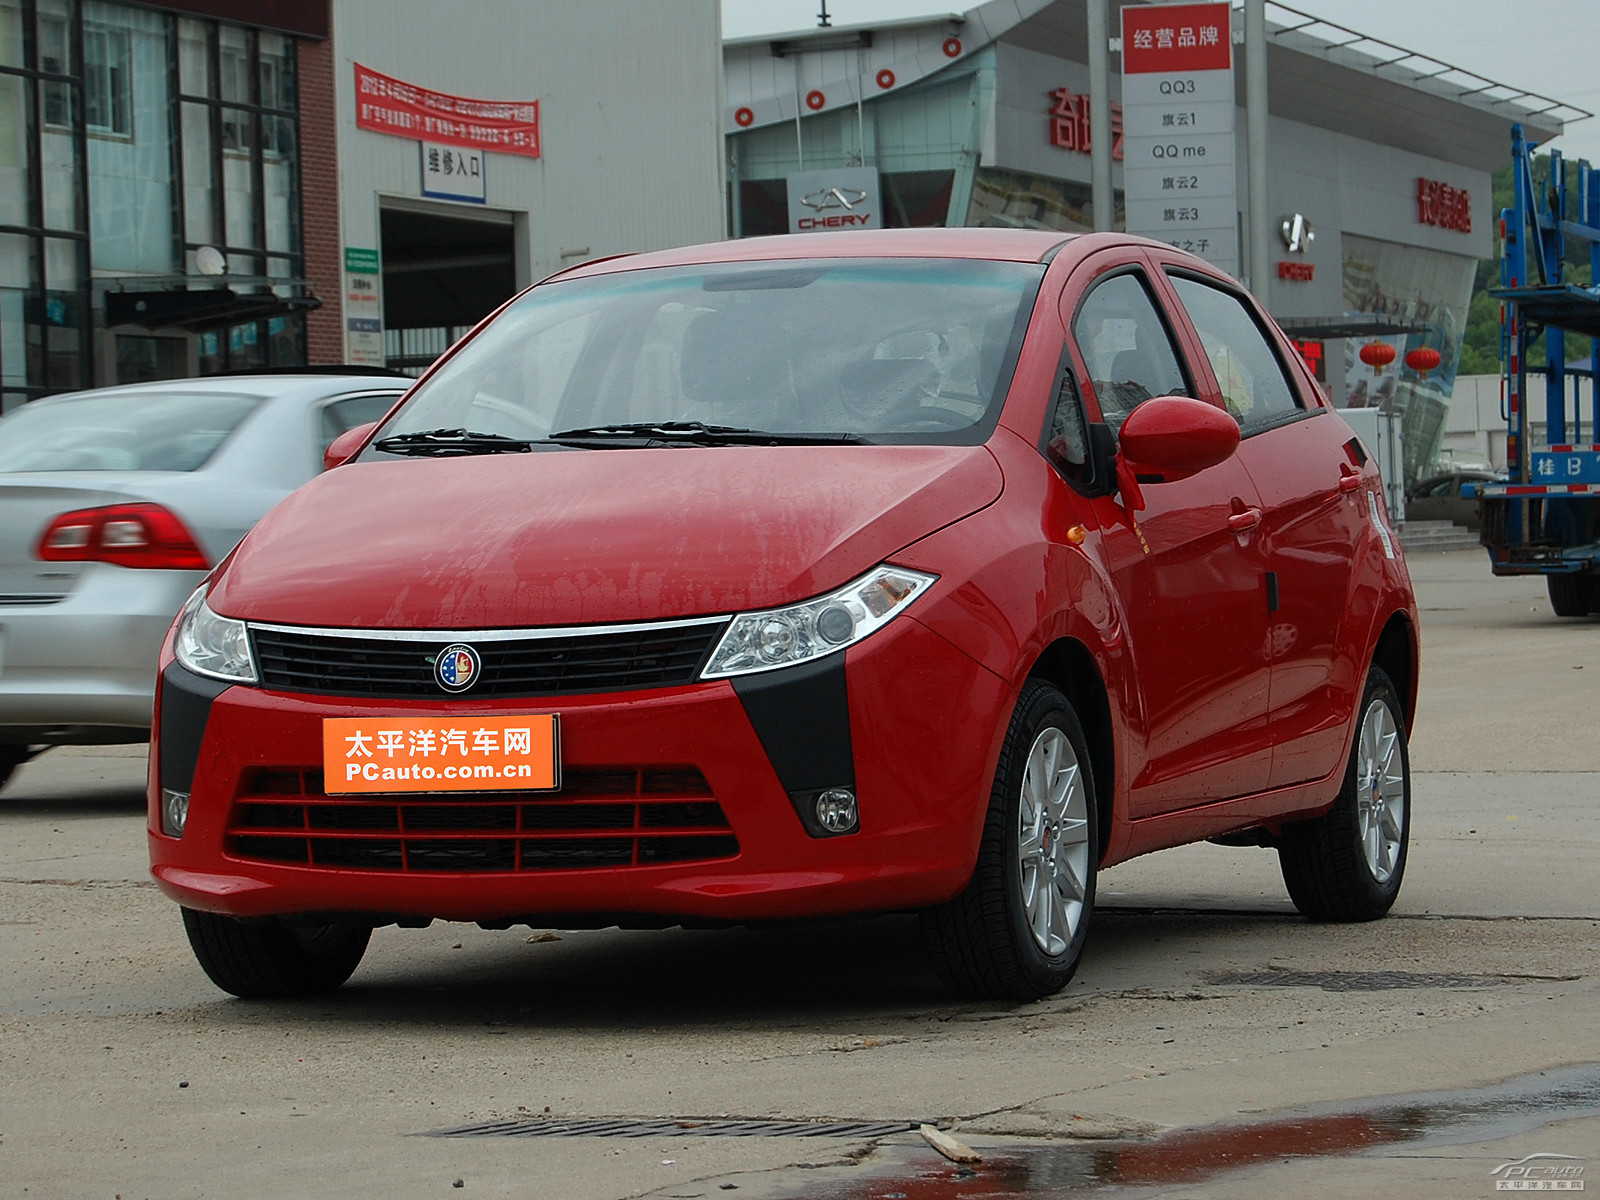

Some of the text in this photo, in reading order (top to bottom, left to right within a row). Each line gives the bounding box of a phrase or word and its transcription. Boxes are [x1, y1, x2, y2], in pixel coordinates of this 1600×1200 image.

[1133, 25, 1220, 50] 经营品牌
[1159, 80, 1196, 95] QQ3
[1161, 112, 1197, 127] 旗云1
[1152, 144, 1207, 159] QQ me
[428, 147, 480, 177] 维修入口
[1161, 175, 1199, 191] 旗云2
[797, 213, 871, 230] CHERY
[1162, 207, 1200, 222] 旗云3
[344, 728, 531, 758] 太平洋汽车网
[345, 762, 532, 781] PCauto.com.cn
